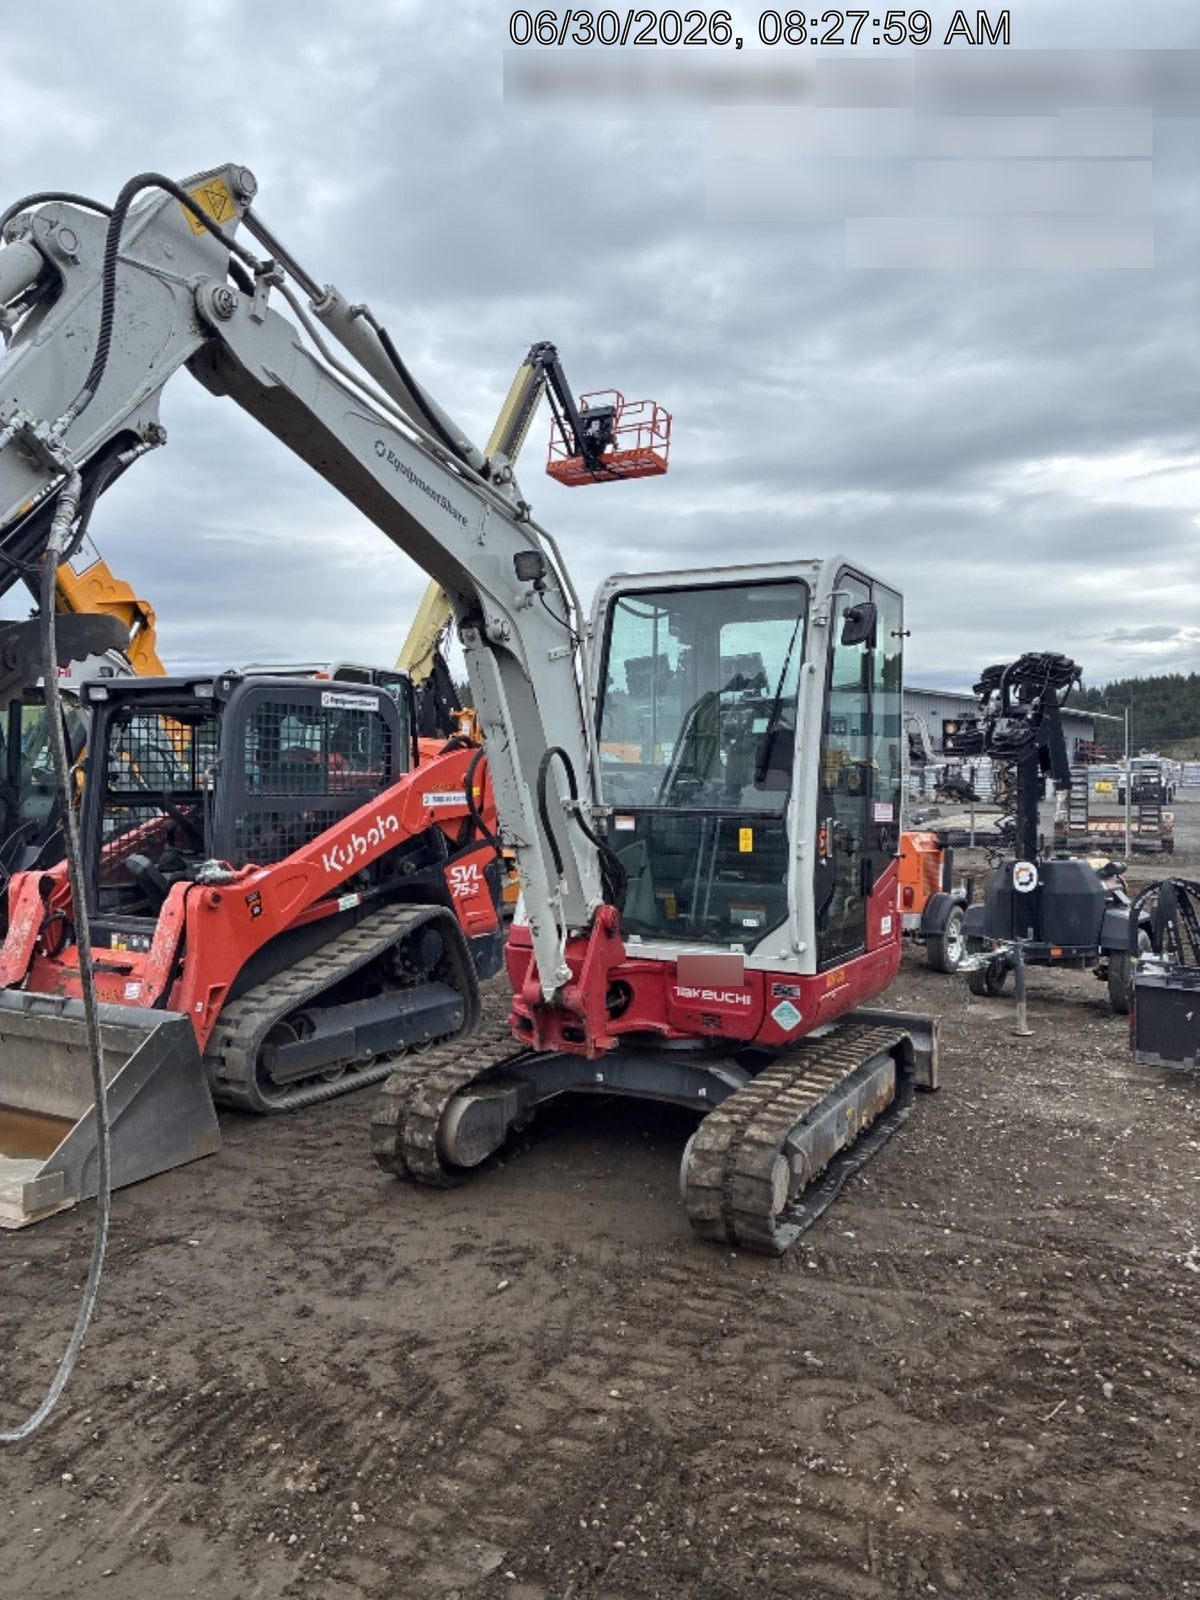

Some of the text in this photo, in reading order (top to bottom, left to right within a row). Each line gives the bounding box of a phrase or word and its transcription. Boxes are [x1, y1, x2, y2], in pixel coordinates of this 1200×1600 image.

[386, 449, 469, 527] EquipmentShare
[321, 814, 399, 873] Kubota
[449, 863, 483, 884] SVL
[452, 882, 479, 897] 75-2
